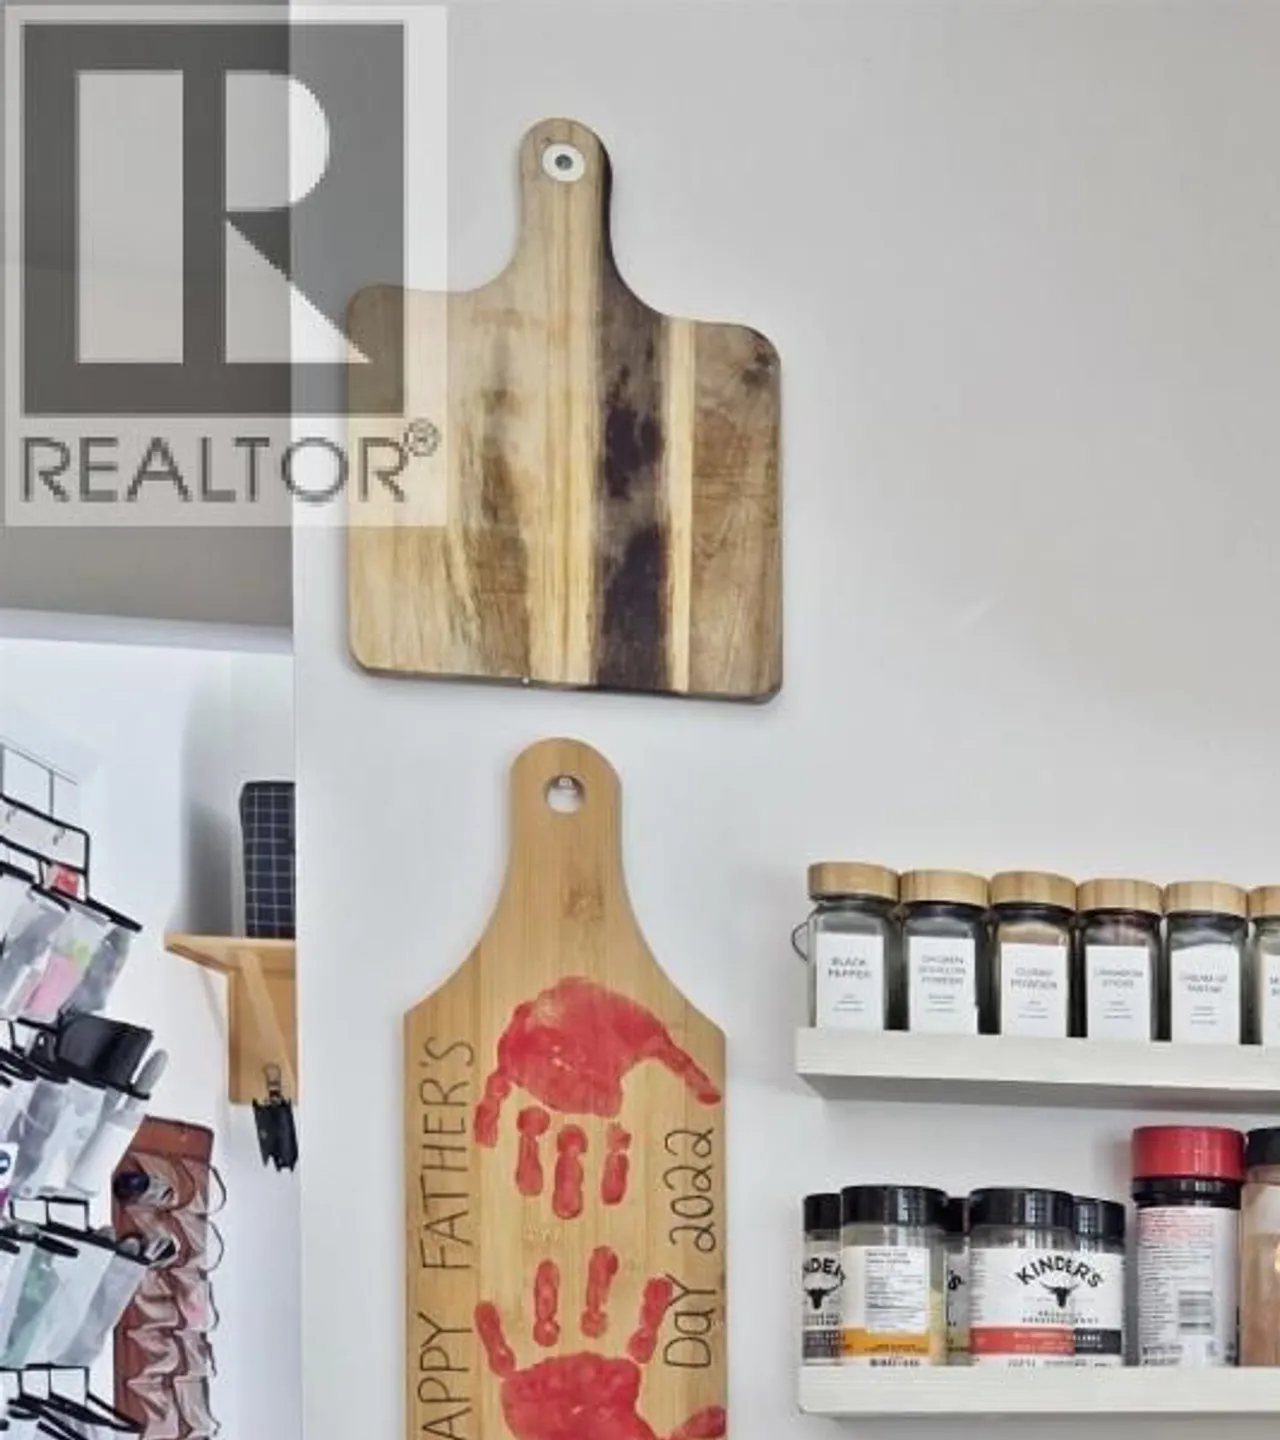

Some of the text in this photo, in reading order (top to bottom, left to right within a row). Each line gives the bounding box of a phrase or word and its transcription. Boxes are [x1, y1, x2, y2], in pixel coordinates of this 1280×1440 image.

[417, 1035, 475, 1270] FATHER'S
[662, 1127, 717, 1254] 2022
[1015, 1254, 1104, 1290] KINDER'S
